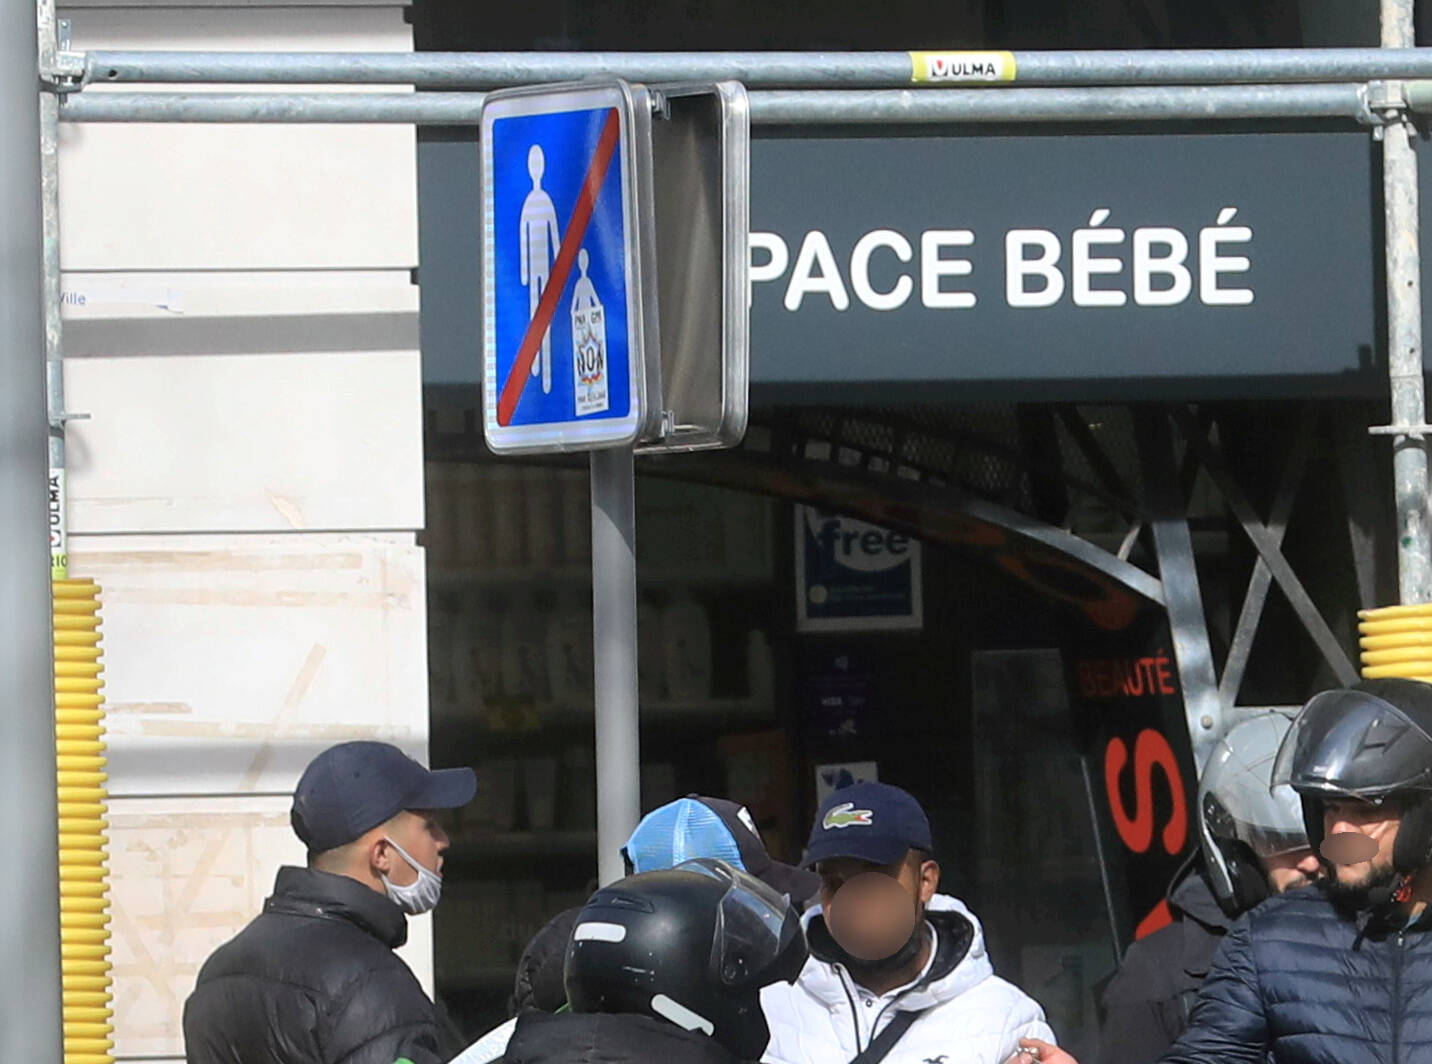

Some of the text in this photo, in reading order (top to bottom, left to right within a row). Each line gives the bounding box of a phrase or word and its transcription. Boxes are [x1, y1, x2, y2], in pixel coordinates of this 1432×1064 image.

[952, 62, 996, 76] ULMA
[749, 207, 1255, 312] PACE BÉBÉ
[49, 475, 61, 526] ULMA
[1079, 650, 1175, 697] BEAUTÉ
